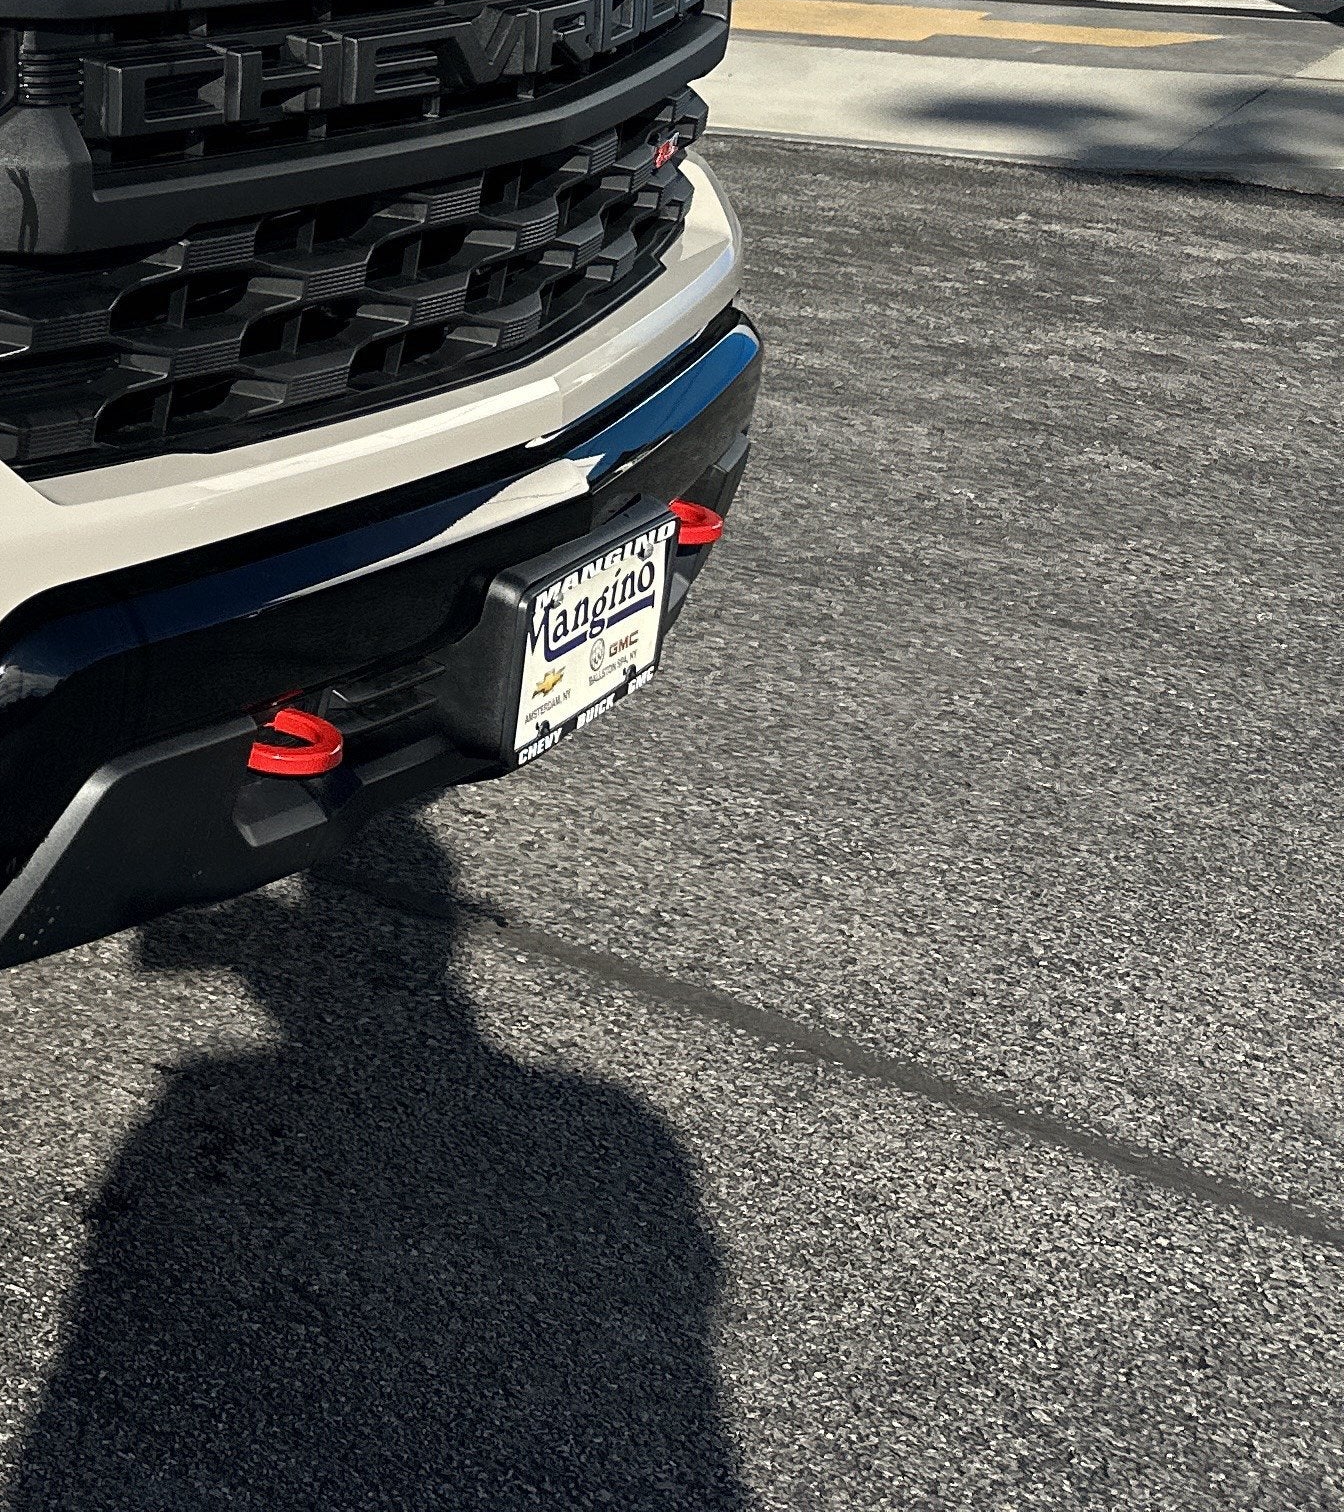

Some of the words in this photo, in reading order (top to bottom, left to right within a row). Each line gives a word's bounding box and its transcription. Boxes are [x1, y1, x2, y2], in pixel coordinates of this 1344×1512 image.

[525, 560, 656, 662] Mangino
[533, 520, 676, 609] MANGINO
[608, 629, 639, 658] GMC
[517, 727, 563, 766] CHEVY
[576, 692, 616, 730] BUICK
[627, 665, 655, 695] GMC
